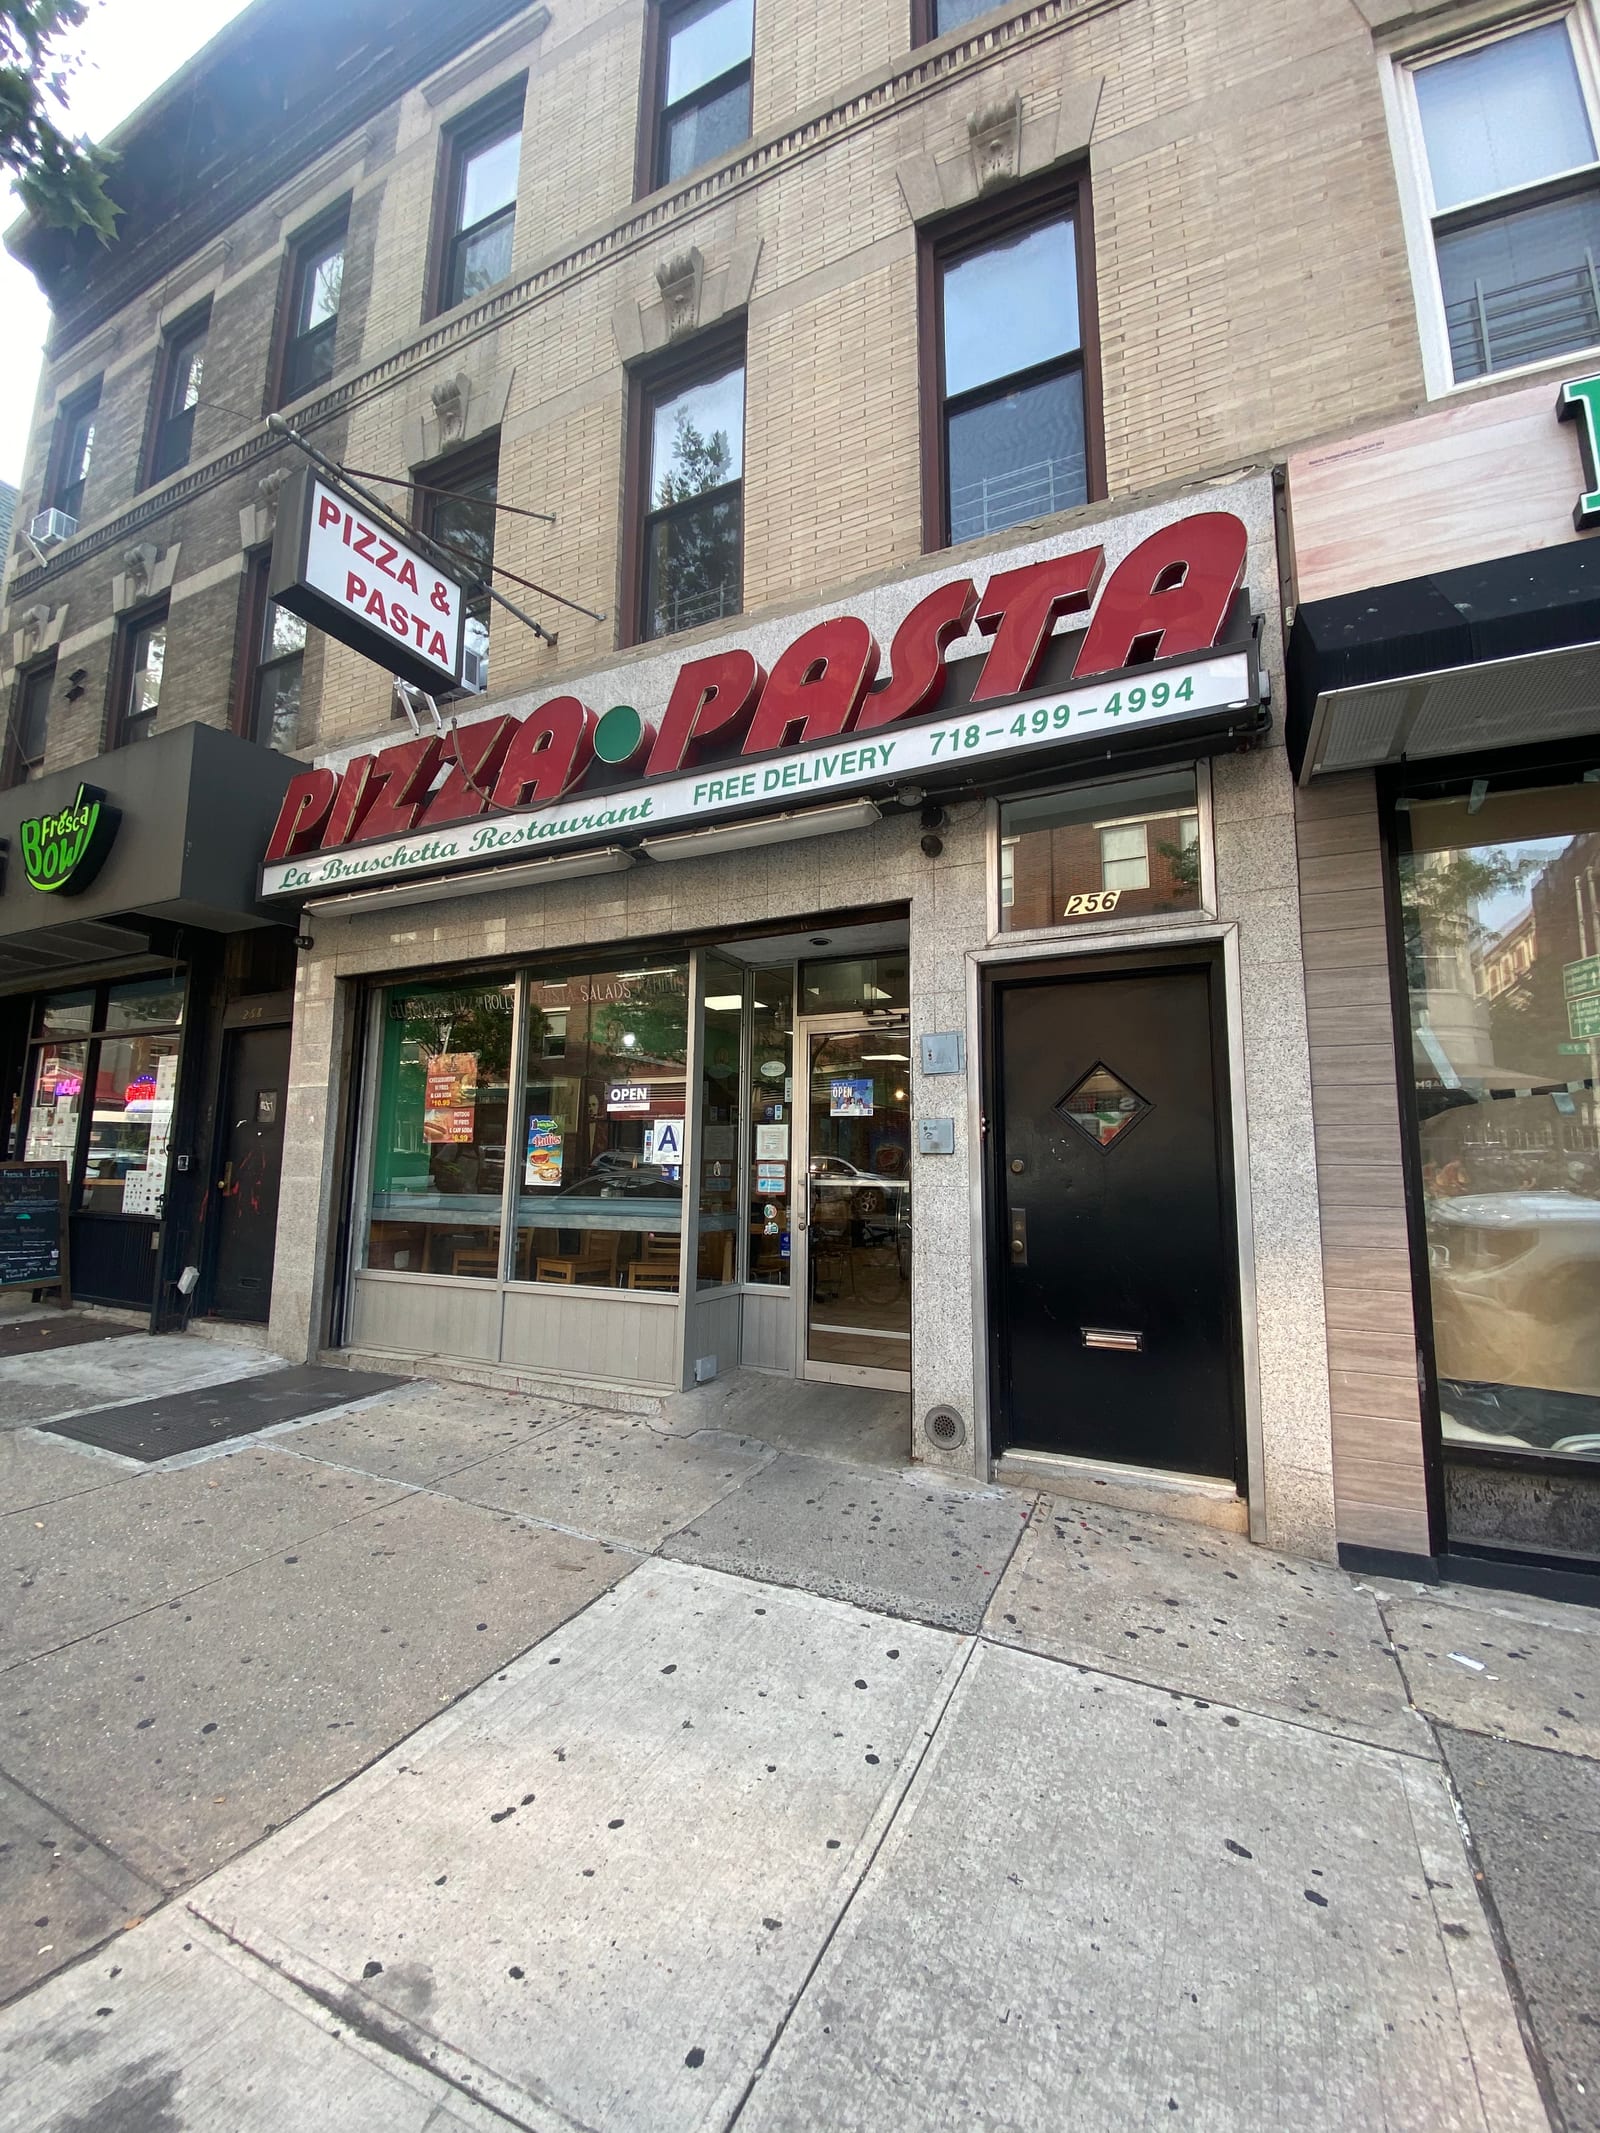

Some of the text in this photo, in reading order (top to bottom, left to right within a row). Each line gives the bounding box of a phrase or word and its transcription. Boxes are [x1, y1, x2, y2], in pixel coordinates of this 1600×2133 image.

[318, 495, 451, 616] PIZZA &
[345, 571, 449, 665] PASTA
[266, 511, 1249, 861] PIZZA PASTA
[693, 676, 1196, 806] FREE DELIVERY 718-499-4994
[21, 802, 101, 878] Bowl
[41, 805, 90, 846] Fresca
[278, 798, 654, 890] La Bruschetta Restaurant
[1067, 892, 1116, 914] 256
[580, 981, 632, 1003] SALADS
[610, 1087, 648, 1102] OPEN
[832, 1085, 854, 1098] OPEN
[657, 1124, 678, 1152] A
